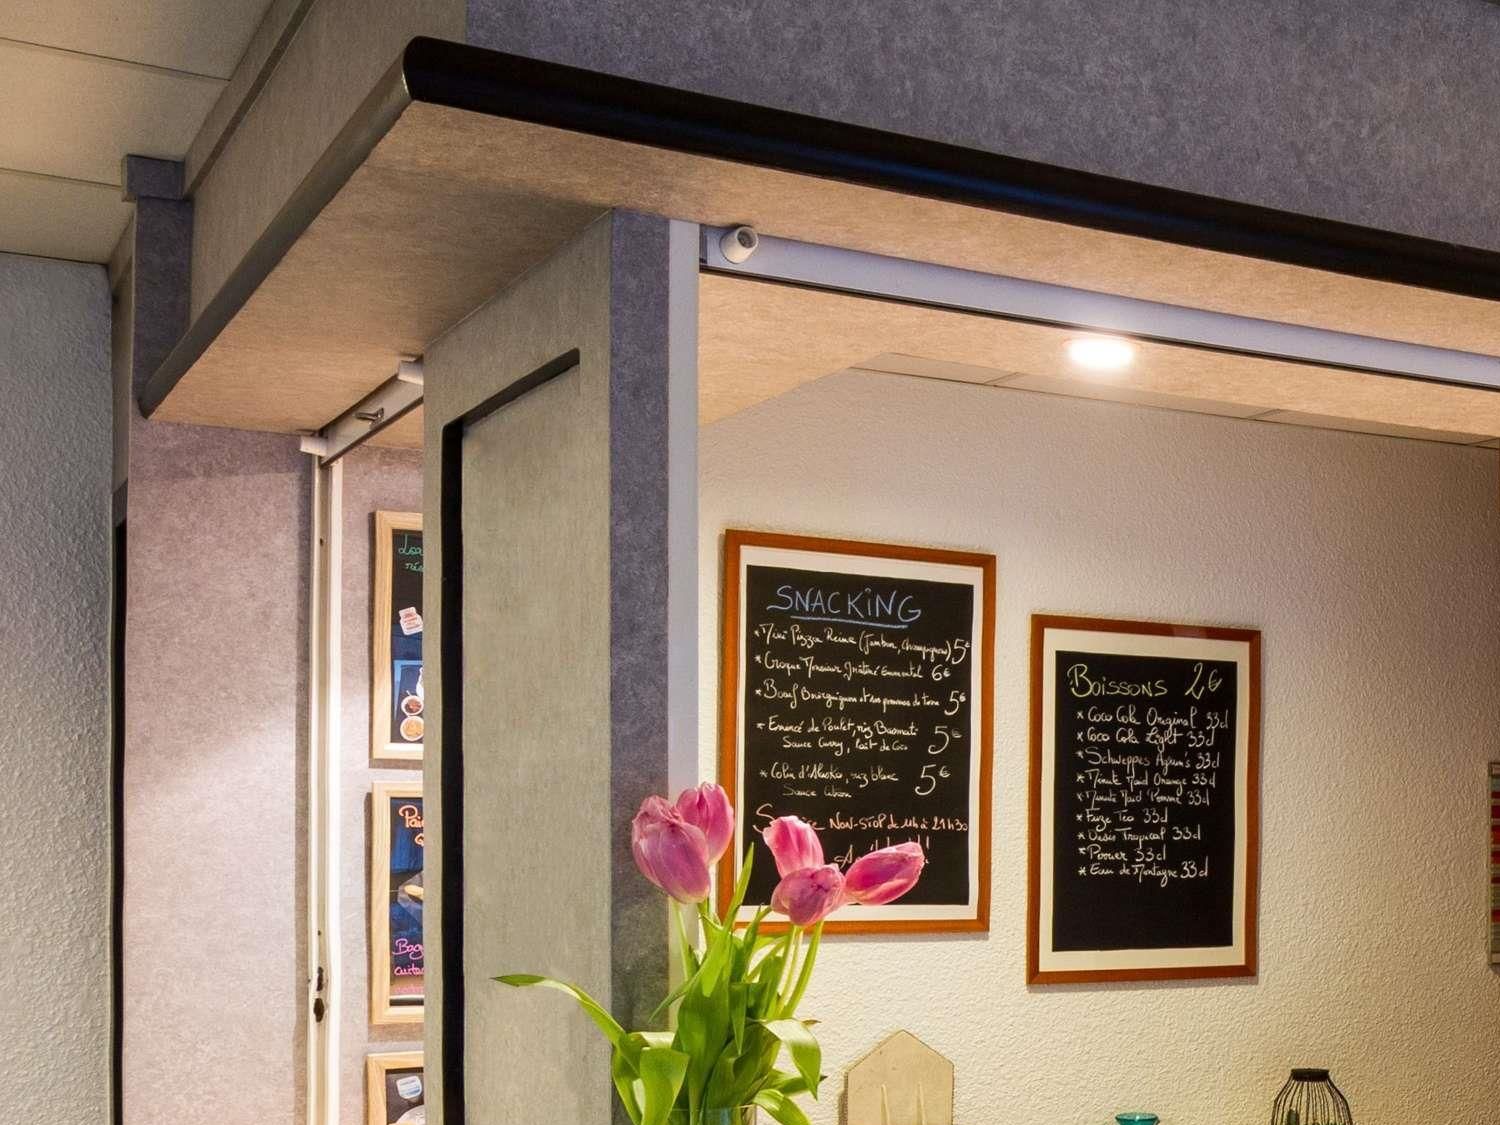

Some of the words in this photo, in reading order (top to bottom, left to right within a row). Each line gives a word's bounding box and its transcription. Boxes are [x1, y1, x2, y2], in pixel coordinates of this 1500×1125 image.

[766, 585, 921, 623] SNACKING
[789, 624, 824, 649] Pizza
[764, 651, 800, 676] Croque
[1184, 662, 1223, 700] 2€
[1146, 706, 1198, 729] Original
[1084, 746, 1151, 776] Schweppes
[392, 938, 424, 960] Bag
